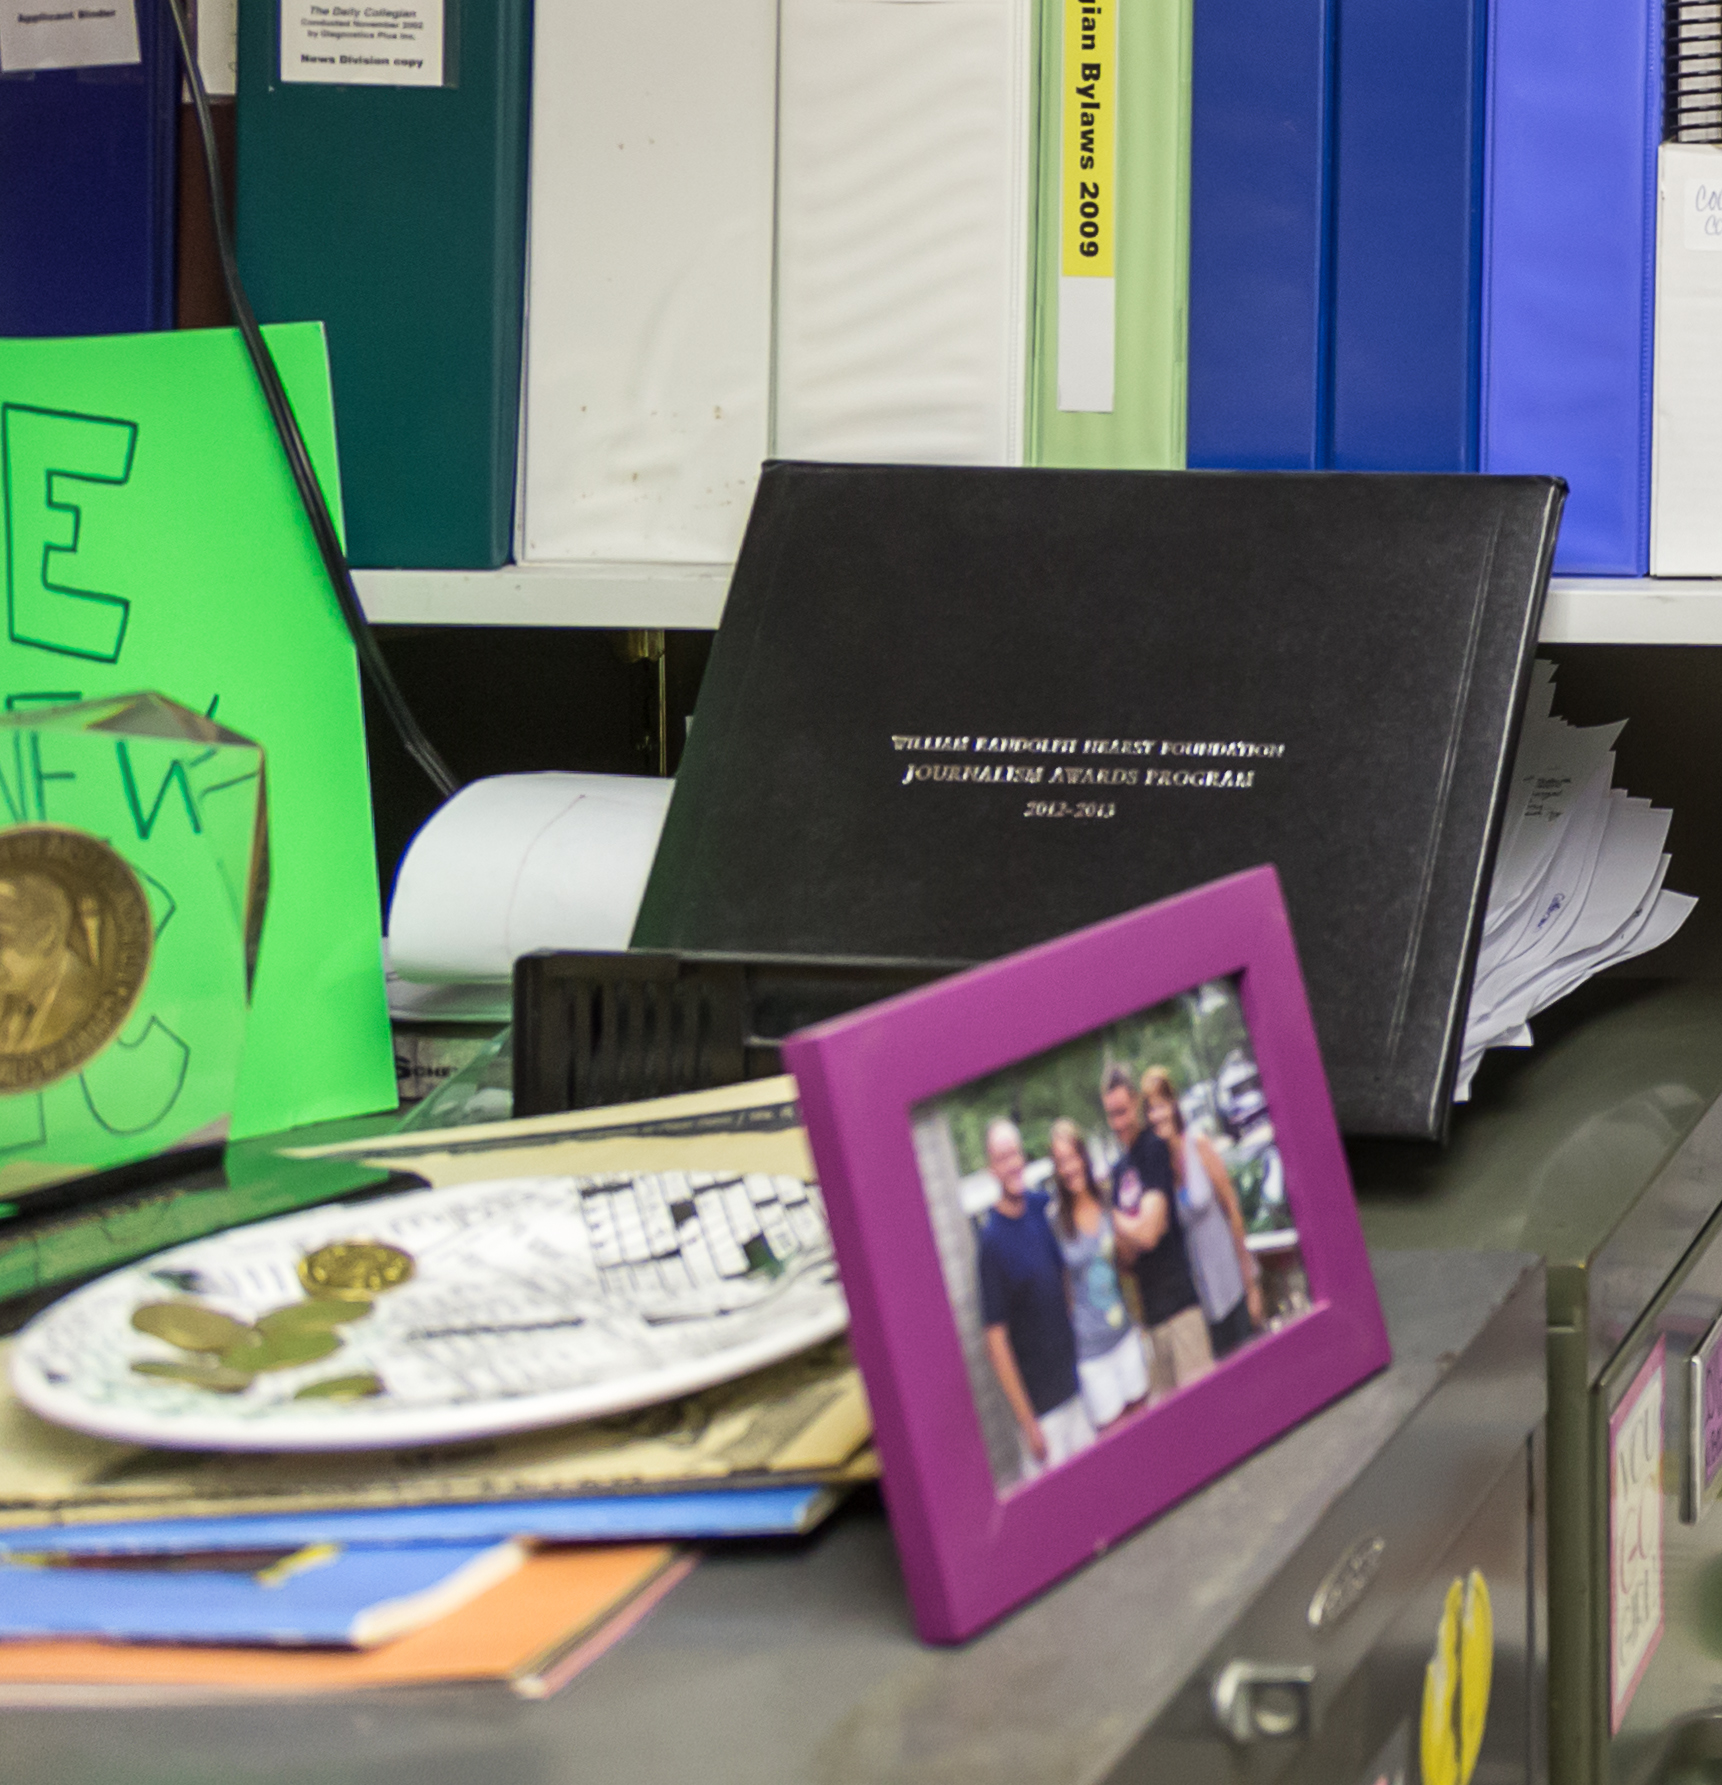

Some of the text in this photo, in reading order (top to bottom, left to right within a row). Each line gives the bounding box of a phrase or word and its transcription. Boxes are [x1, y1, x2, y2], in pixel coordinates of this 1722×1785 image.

[1075, 63, 1102, 172] Bylaws
[1078, 181, 1101, 259] 2009
[902, 764, 1255, 788] JOURNALISM AWARDS PROGRAM
